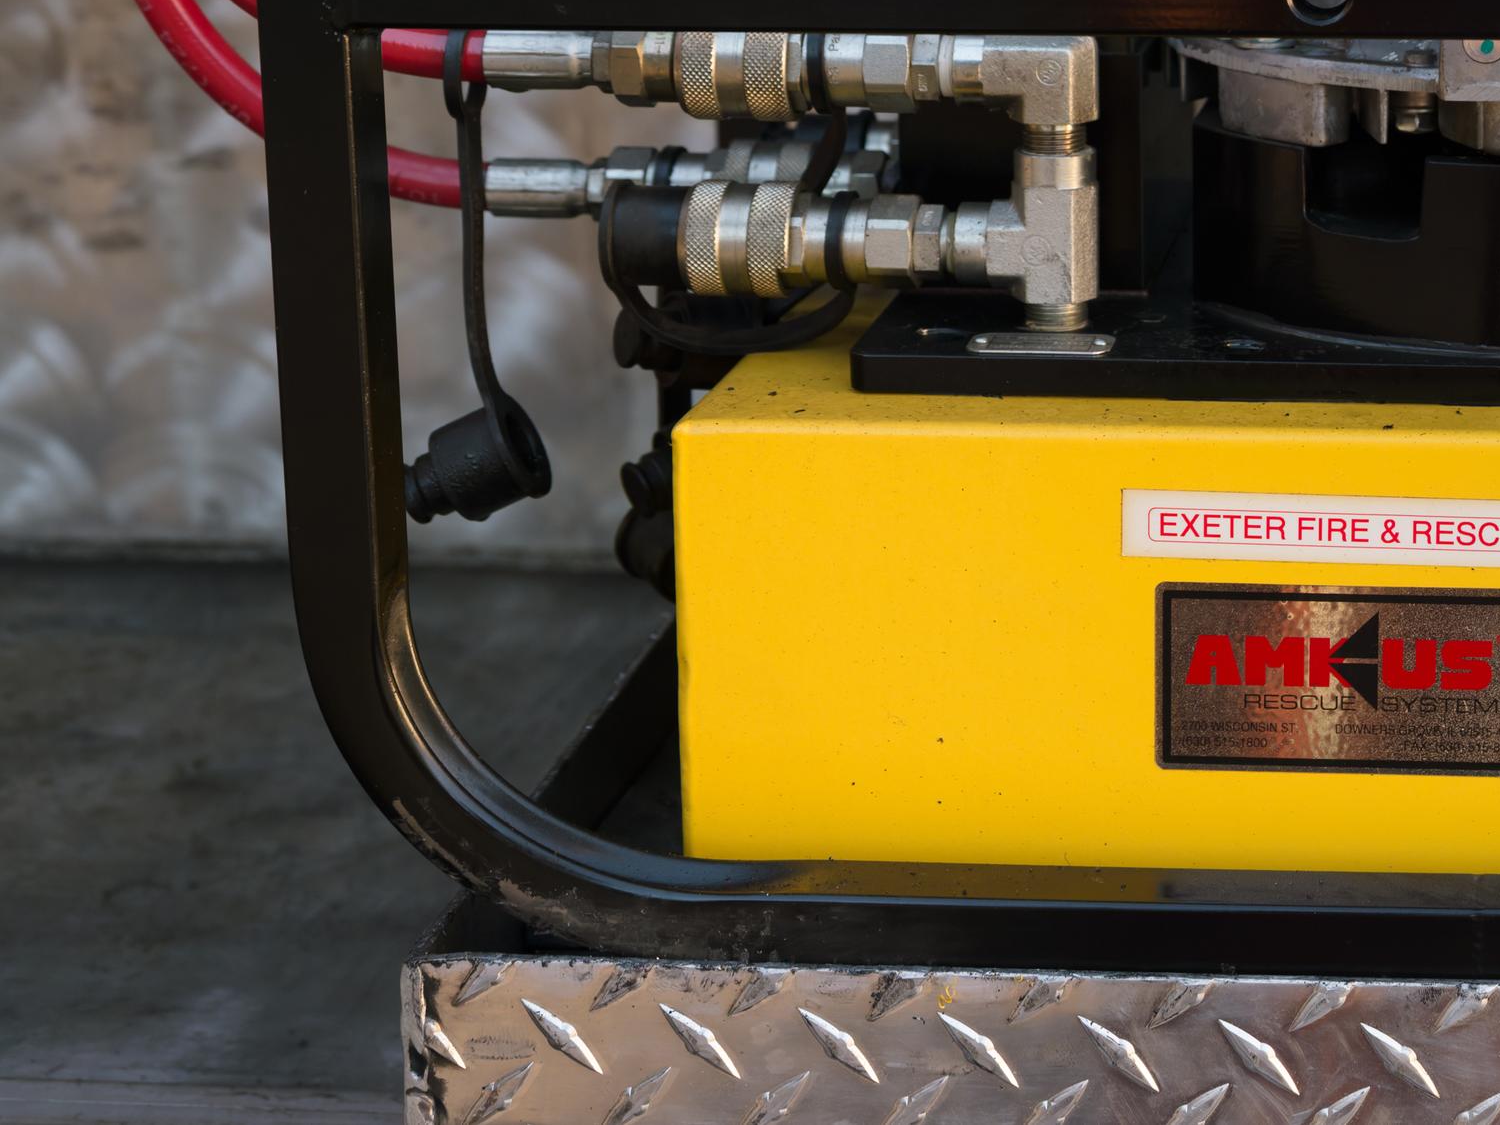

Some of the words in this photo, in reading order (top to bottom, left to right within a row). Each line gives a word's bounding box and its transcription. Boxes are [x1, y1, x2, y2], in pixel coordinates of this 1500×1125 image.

[1158, 512, 1286, 540] EXETER
[1297, 517, 1369, 543] FIRE
[1380, 519, 1401, 544] &
[1185, 634, 1494, 691] AMKUS
[1242, 693, 1356, 711] RESCUE
[1210, 721, 1278, 733] WISCONSIN
[1335, 724, 1396, 736] DOWNERS
